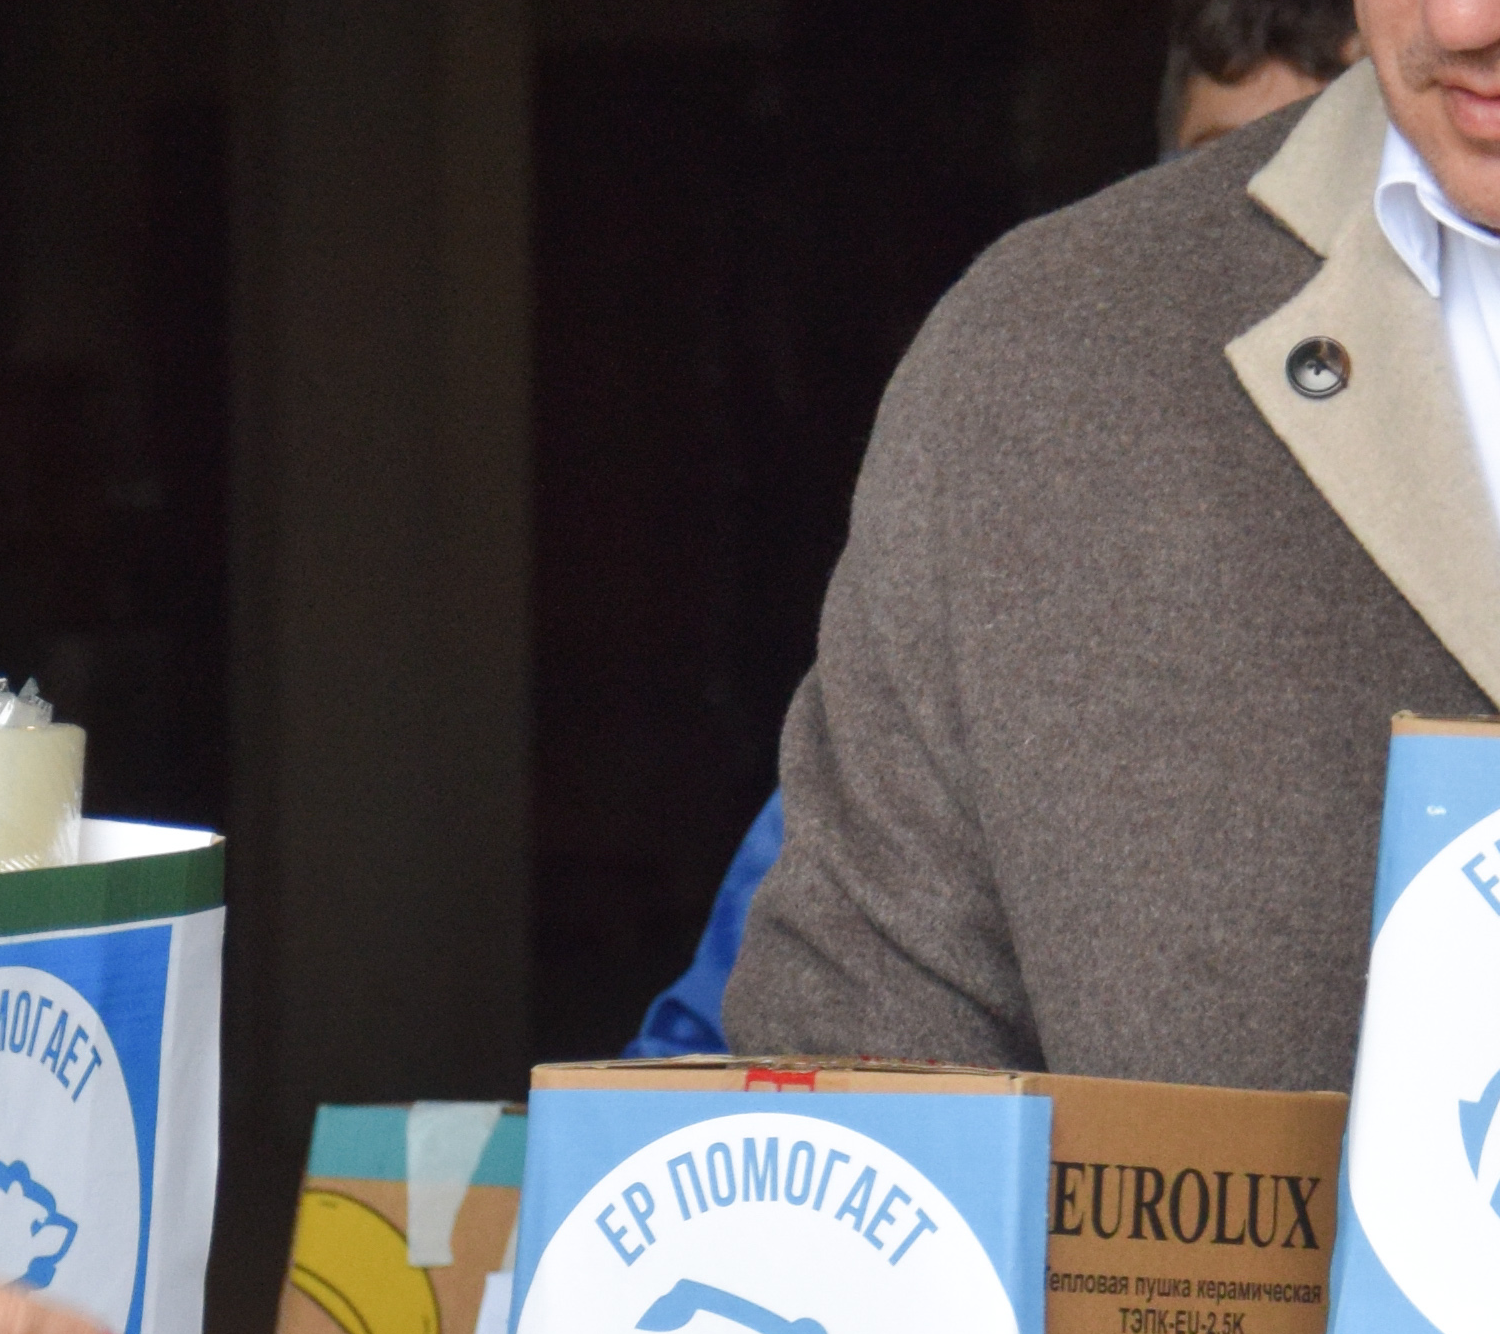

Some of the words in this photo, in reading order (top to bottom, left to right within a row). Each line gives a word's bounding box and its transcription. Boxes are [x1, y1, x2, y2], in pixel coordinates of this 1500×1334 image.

[594, 1181, 657, 1267] ЕР
[666, 1137, 939, 1267] ПОМОГАЕТ
[1048, 1161, 1321, 1250] EUROLUX
[1045, 1266, 1129, 1297] епловая
[1135, 1276, 1191, 1303] пушка
[1197, 1278, 1322, 1305] керамическая
